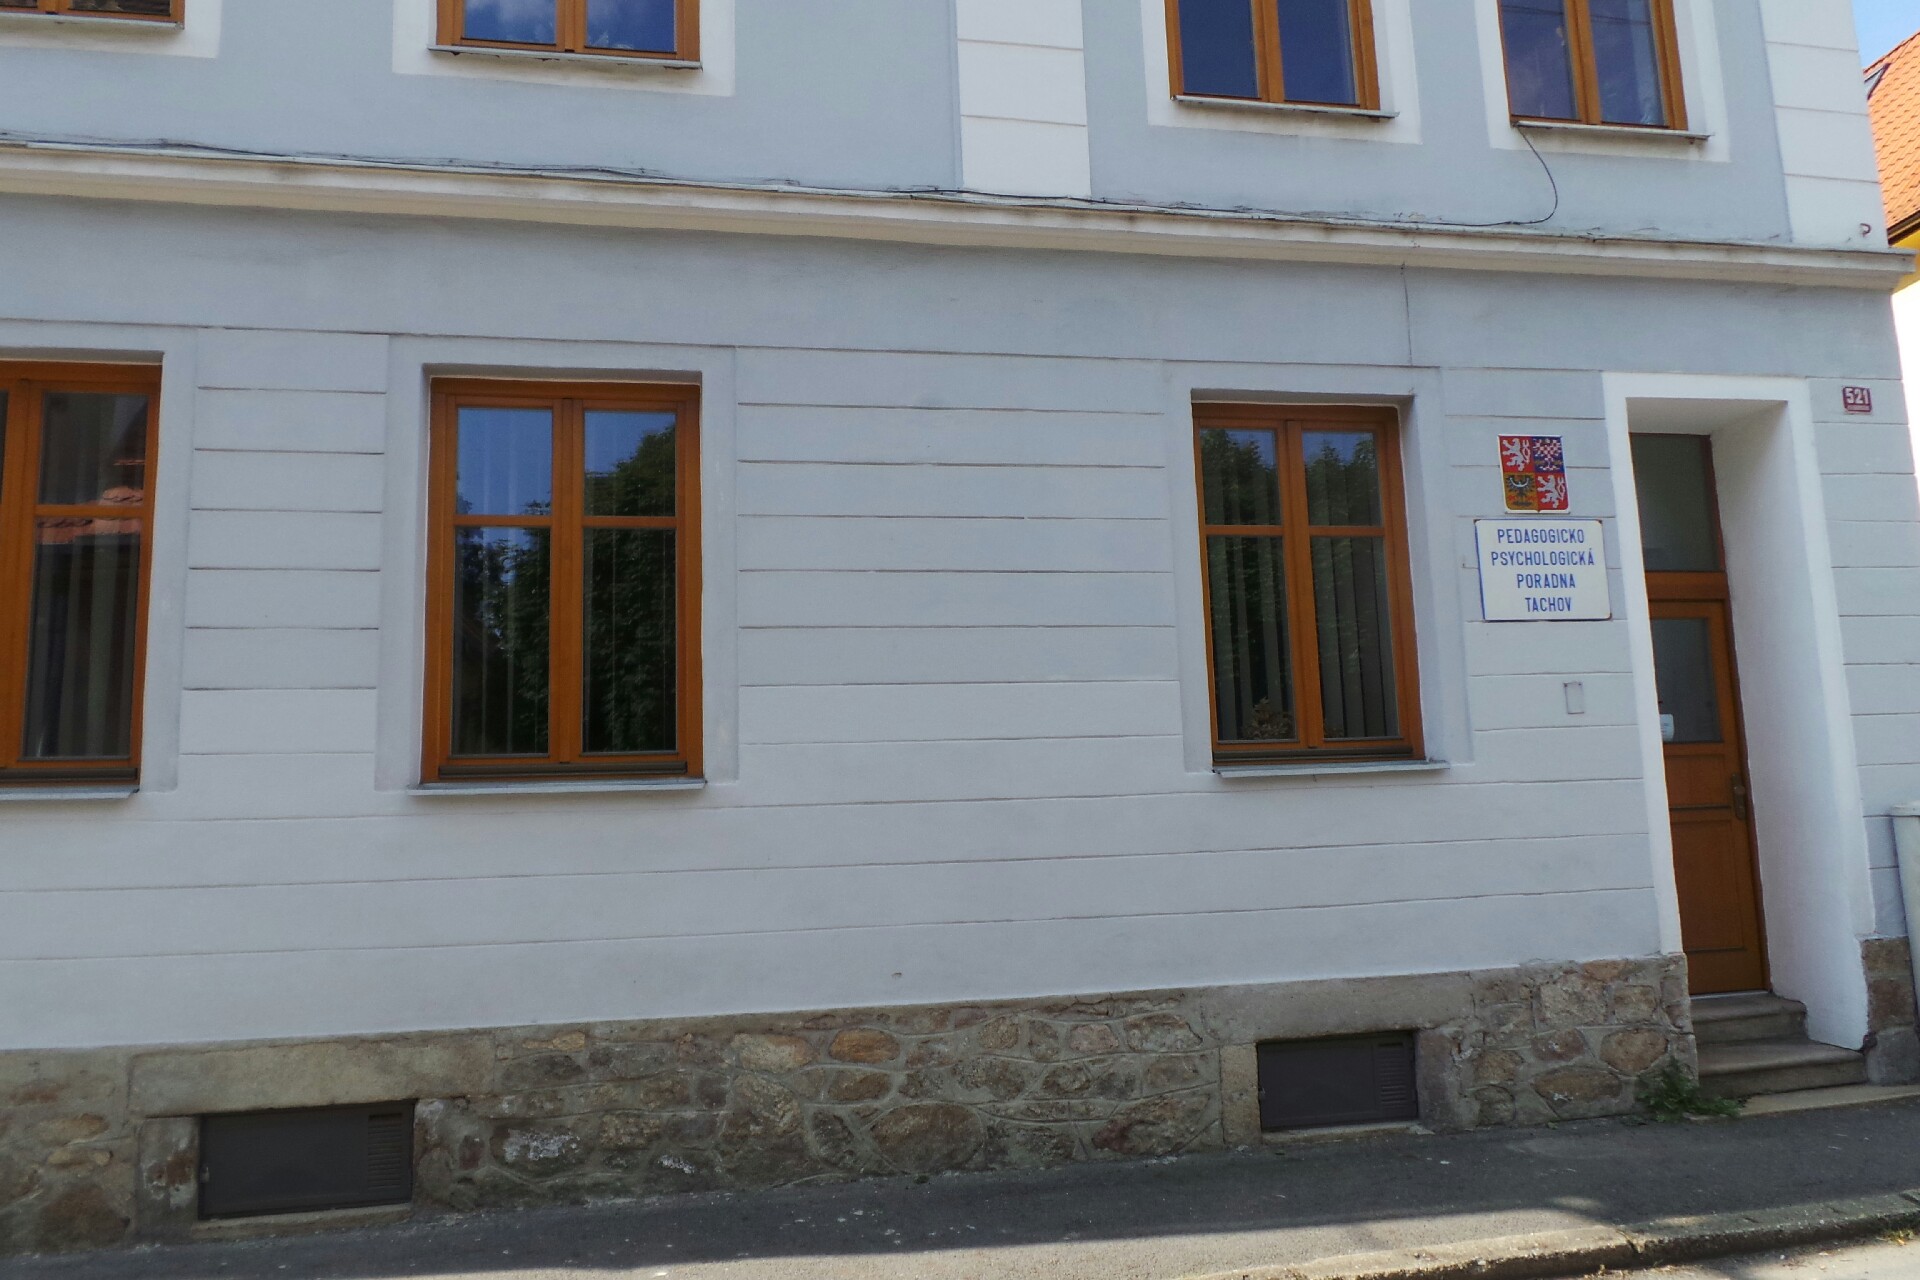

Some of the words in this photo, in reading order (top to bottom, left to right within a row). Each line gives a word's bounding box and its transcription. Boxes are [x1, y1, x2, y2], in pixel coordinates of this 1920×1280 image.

[1845, 387, 1869, 405] 521
[1497, 528, 1585, 544] PEDAGOGICKO
[1491, 548, 1595, 566] PSYCHOLOGICKÁ
[1517, 573, 1576, 589] PORADNA
[1525, 597, 1572, 613] TACHOV
